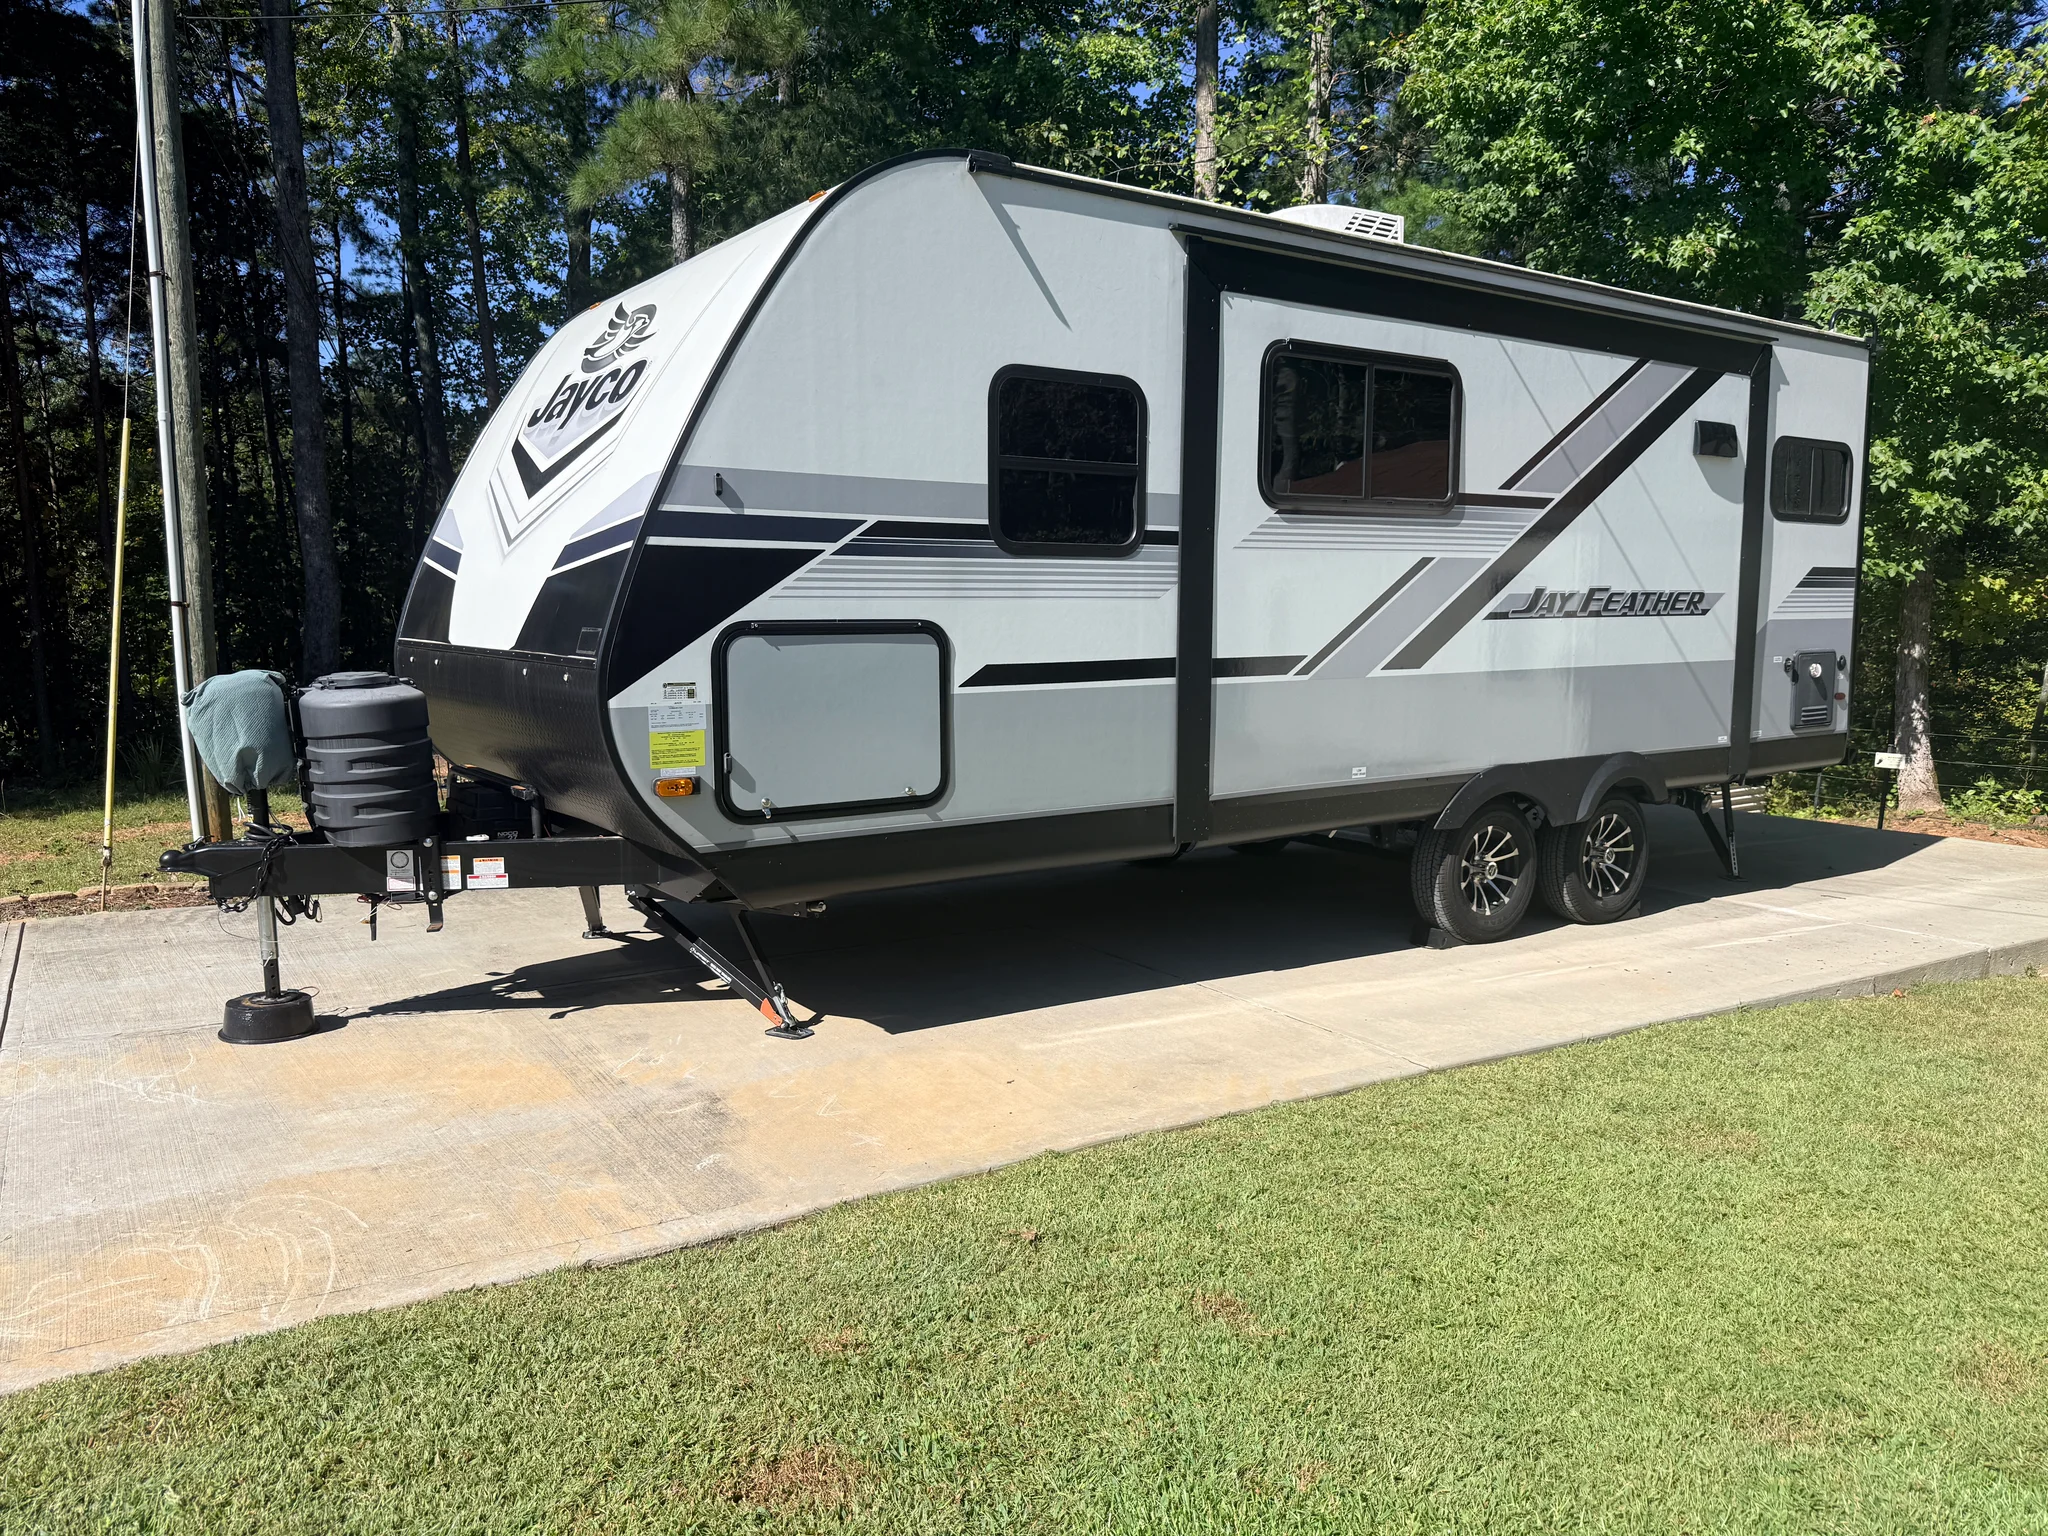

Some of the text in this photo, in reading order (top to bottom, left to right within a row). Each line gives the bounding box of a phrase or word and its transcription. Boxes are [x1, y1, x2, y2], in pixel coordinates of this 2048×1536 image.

[527, 358, 648, 431] Jayco
[1509, 585, 1706, 618] JAY FEATHER
